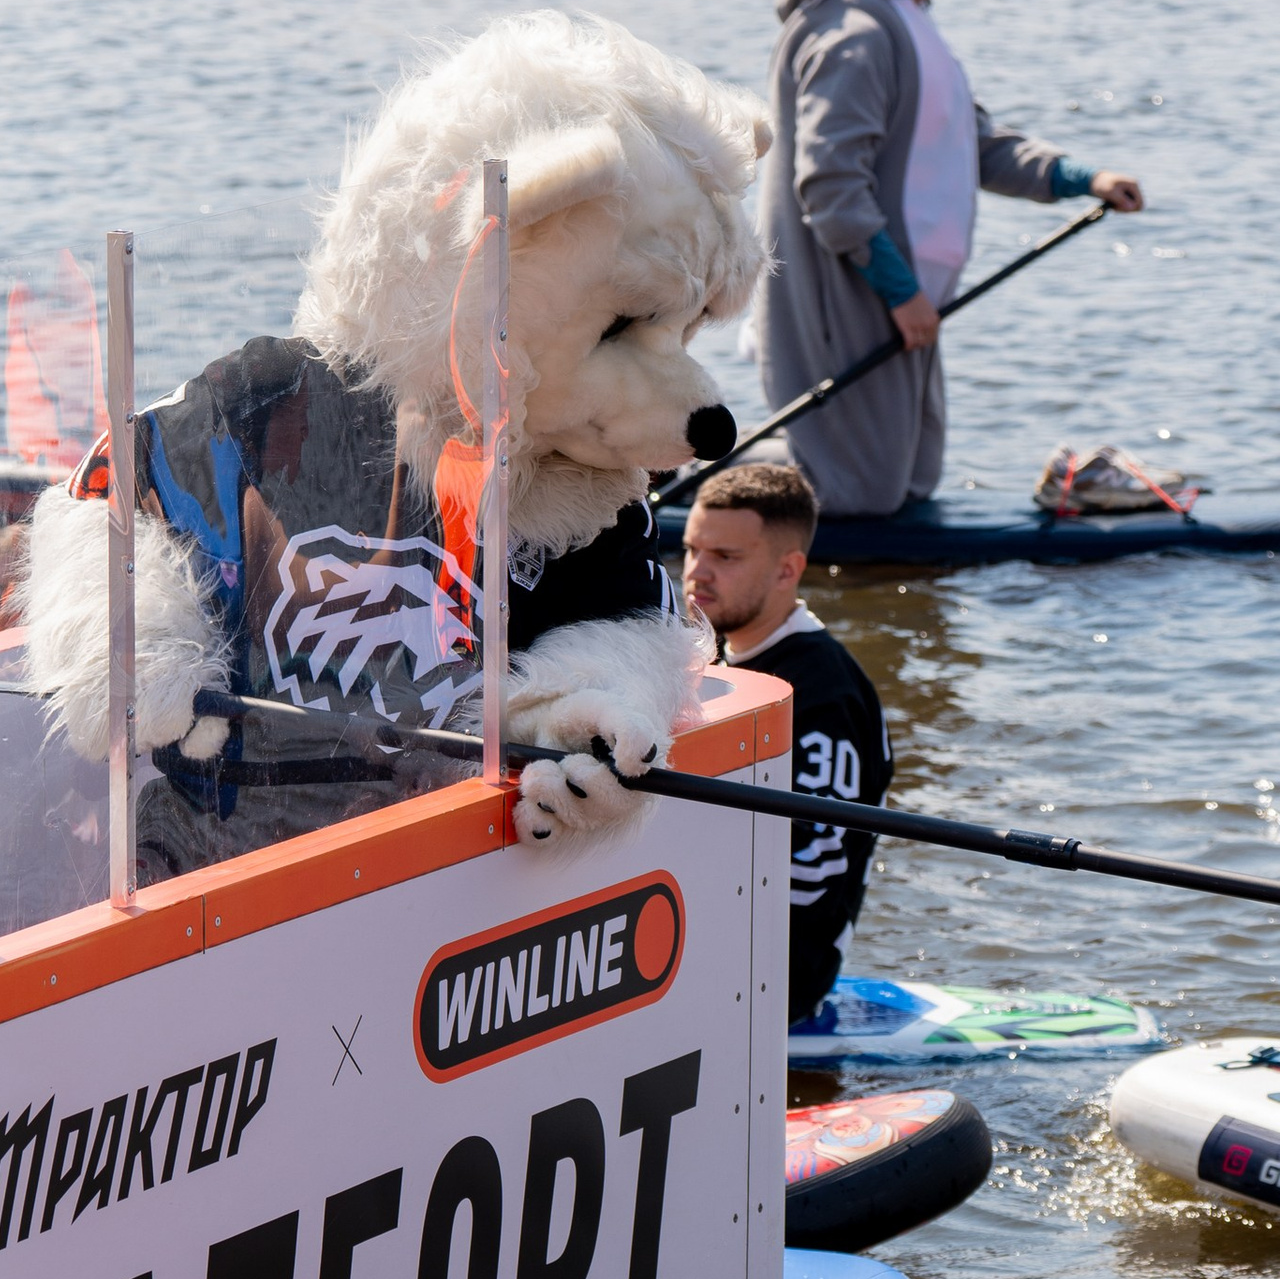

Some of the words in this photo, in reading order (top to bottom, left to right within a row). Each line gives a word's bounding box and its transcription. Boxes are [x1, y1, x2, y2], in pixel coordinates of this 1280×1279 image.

[796, 731, 861, 799] 30
[437, 914, 627, 1051] WINLINE
[1259, 1158, 1280, 1188] G
